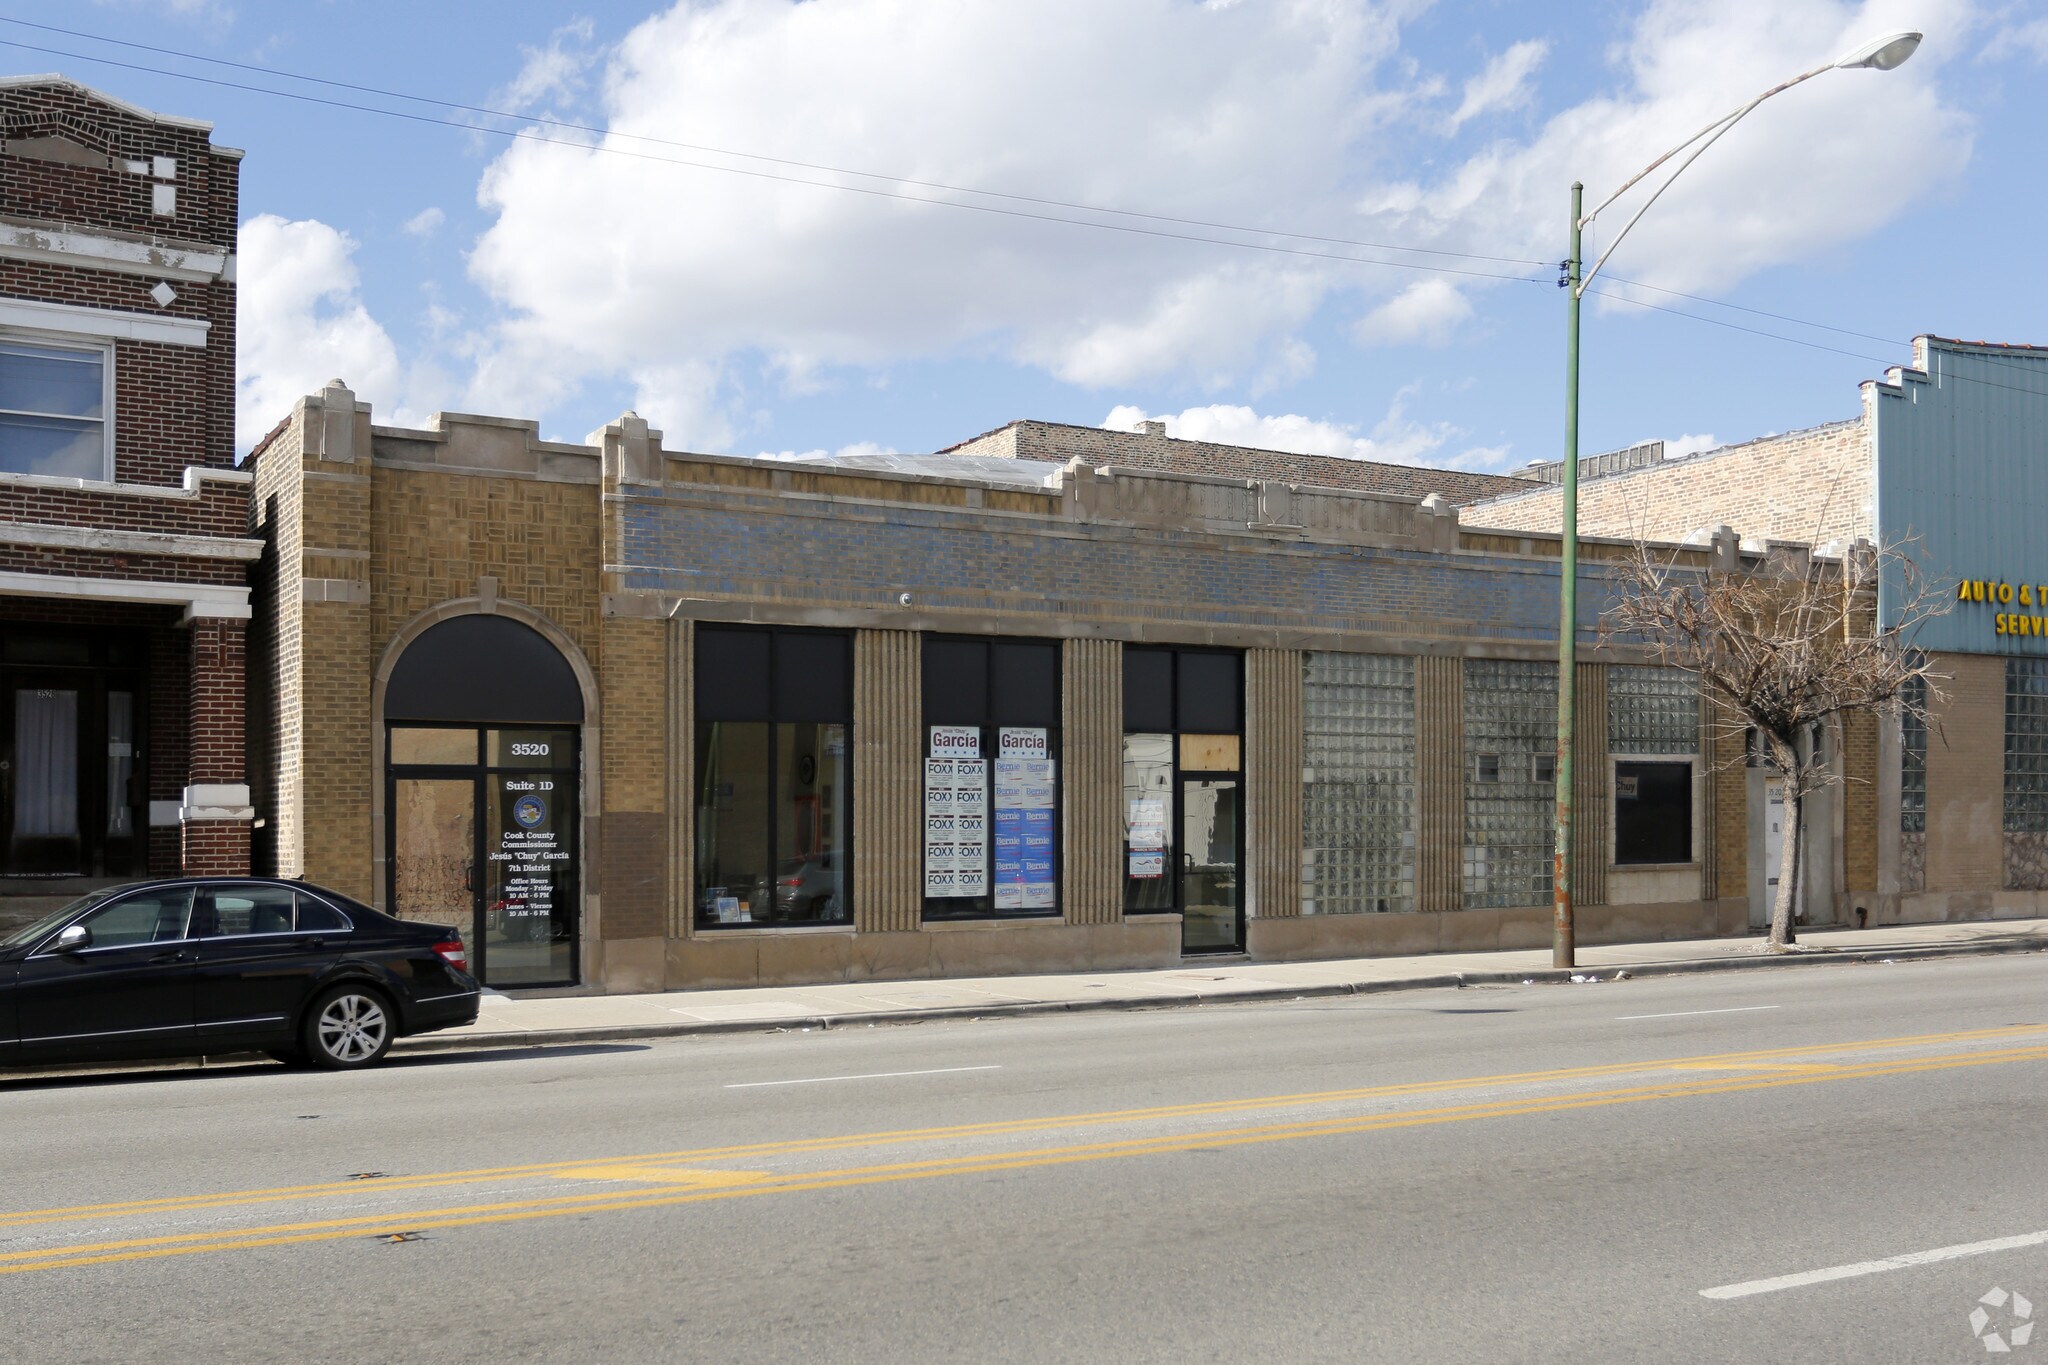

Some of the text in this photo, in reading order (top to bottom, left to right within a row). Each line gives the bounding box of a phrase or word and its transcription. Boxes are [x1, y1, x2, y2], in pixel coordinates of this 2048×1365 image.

[1959, 579, 2013, 604] AUTO
[2019, 584, 2032, 606] &
[933, 732, 977, 748] García
[1001, 734, 1044, 749] García
[512, 743, 549, 756] 3520
[928, 763, 953, 774] FOXX
[957, 764, 983, 775] FOXX
[506, 781, 554, 791] Suite 1D
[957, 792, 982, 802] FOXX
[996, 811, 1020, 820] Bernie
[1026, 811, 1050, 820] Bernie
[928, 819, 954, 829] FOXX
[504, 831, 555, 840] Cook County
[1026, 836, 1050, 845] Bernie
[502, 841, 558, 849] Commissioner
[996, 837, 1020, 845] Bernie
[543, 852, 570, 860] García
[928, 847, 954, 857] FOXX
[508, 864, 551, 872] 7th District
[996, 861, 1020, 870] Bernie
[1026, 861, 1050, 870] Bernie
[928, 874, 954, 885] FOXX
